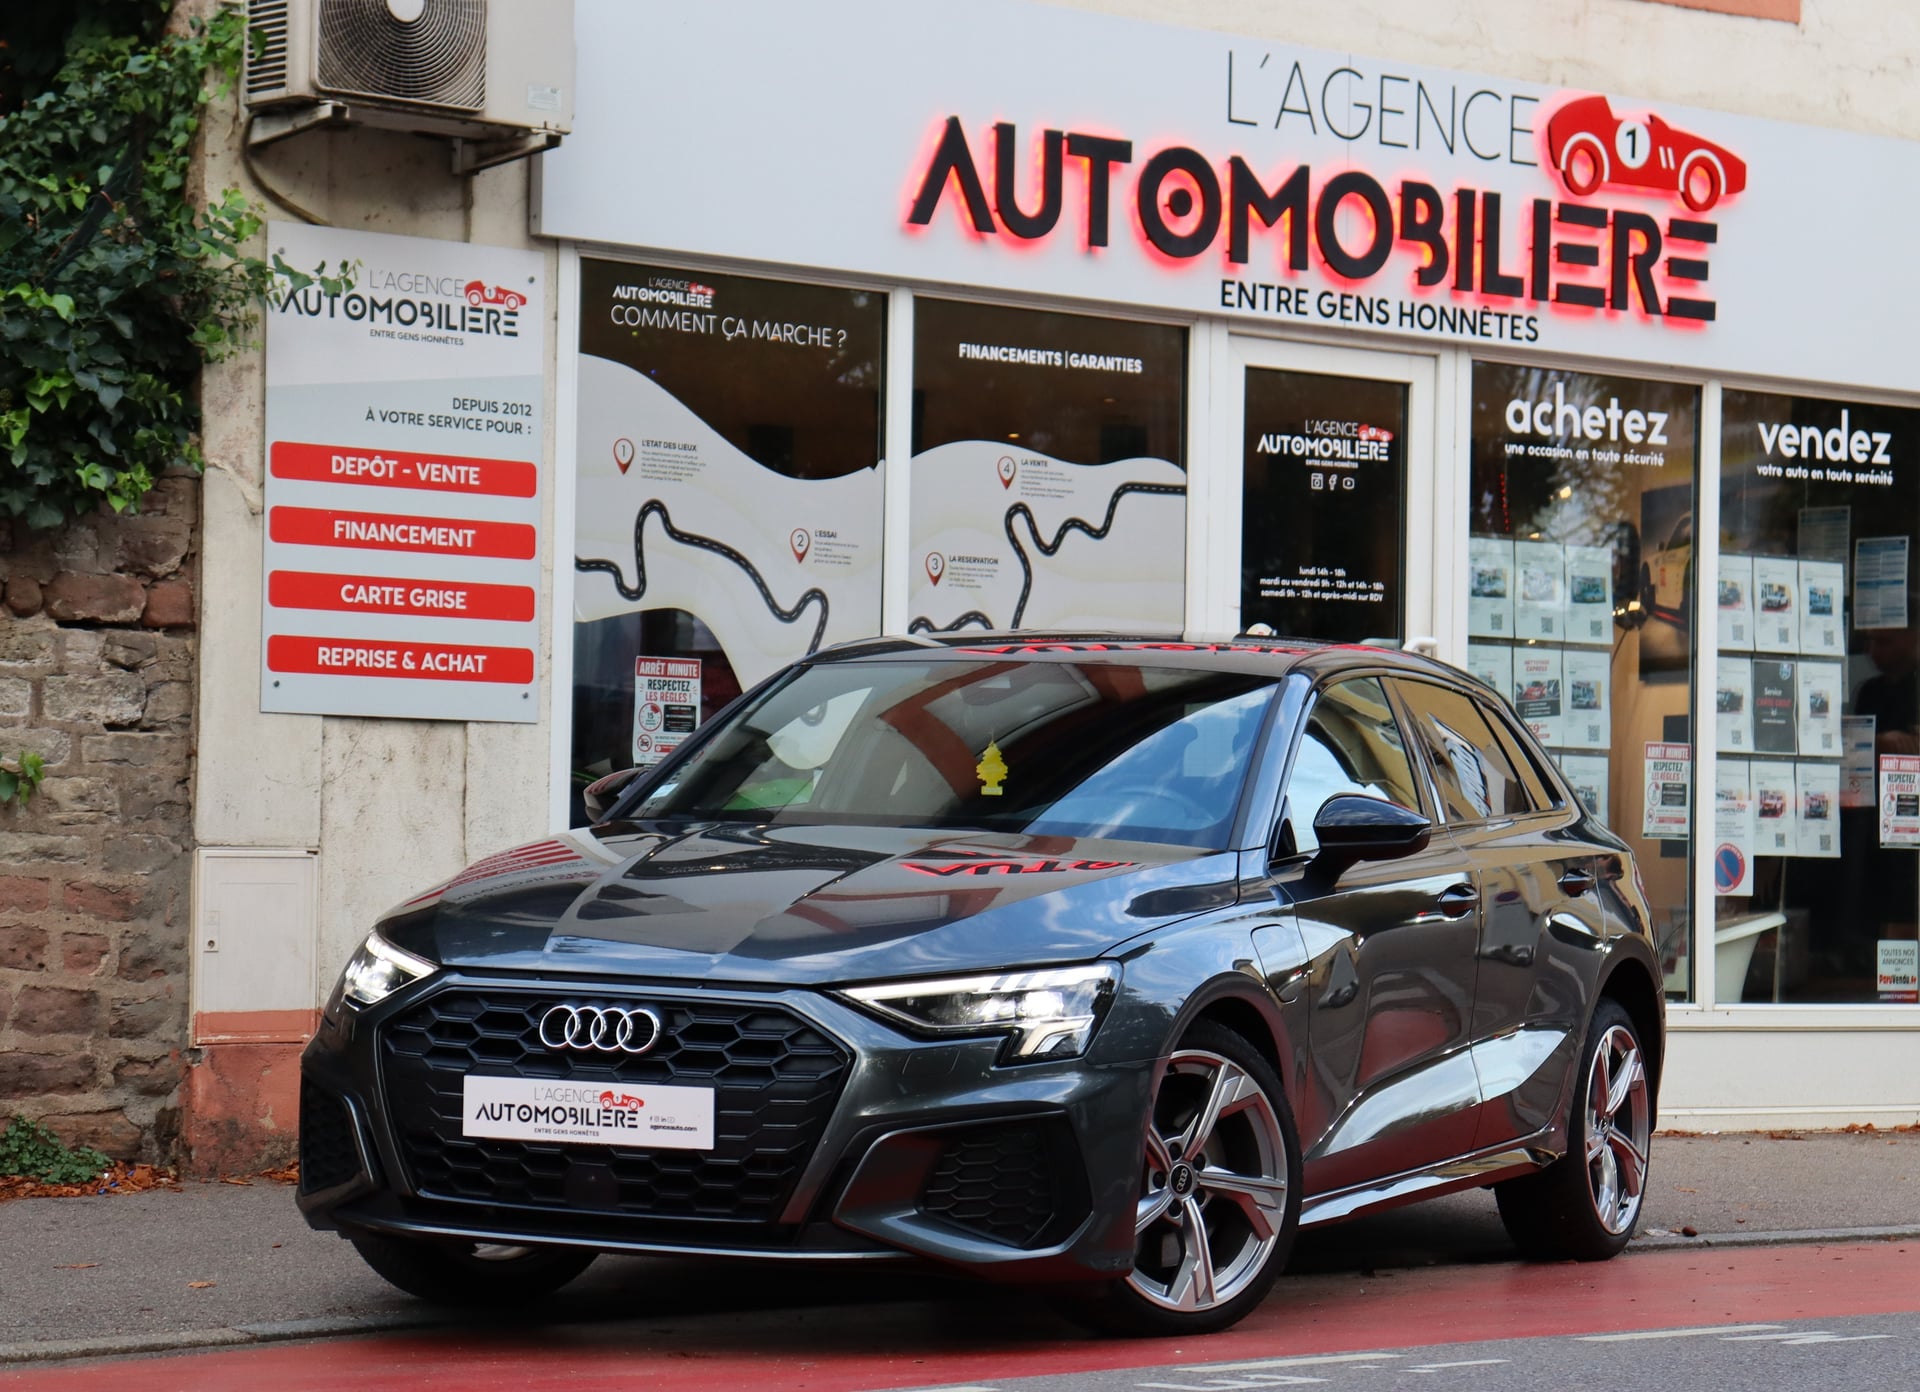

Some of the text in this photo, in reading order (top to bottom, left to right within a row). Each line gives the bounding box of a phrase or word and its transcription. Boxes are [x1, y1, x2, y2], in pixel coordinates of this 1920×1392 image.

[1227, 50, 1540, 167] L'AGENCE
[1624, 128, 1637, 159] 1
[369, 268, 465, 298] L'AGENCE
[648, 276, 690, 291] L'AGENCE
[1220, 279, 1540, 343] ENTRE GENS HONNÊTES
[611, 304, 847, 348] COMMENT ÇA MARCHE ?
[369, 328, 464, 346] ENTRE GENS HONNÊTES
[959, 342, 1142, 374] FINANCEMENTS GARANTIES
[452, 397, 532, 417] DEPUIS 2012
[1505, 382, 1669, 446] achetez
[365, 406, 375, 421] À
[379, 409, 424, 425] VOTRE
[428, 413, 482, 431] SERVICE
[486, 419, 523, 434] POUR
[1304, 419, 1359, 437] L'AGENCE
[663, 441, 677, 450] DES
[1758, 409, 1892, 465] vendez
[1504, 443, 1665, 467] une occasion en toute sécurité
[331, 454, 398, 478] DEPÔT
[416, 462, 480, 486] VENTE
[1003, 463, 1010, 474] 4
[1756, 463, 1783, 477] votre
[1785, 466, 1809, 479] auto
[1811, 469, 1824, 480] en
[1826, 468, 1853, 483] toute
[333, 519, 476, 548] FINANCEMENT
[796, 534, 804, 547] 2
[931, 558, 939, 570] 3
[1299, 565, 1317, 576] lundi
[1259, 576, 1280, 586] mardi
[1291, 578, 1321, 588] vendredi
[340, 583, 467, 610] CARTE GRISE
[317, 646, 487, 673] REPRISE & ACHAT
[640, 659, 698, 677] ARRÊT MINUTE
[647, 679, 690, 692] RESPECTEZ
[645, 691, 658, 702] LES
[533, 1086, 600, 1104] L'AGENCE
